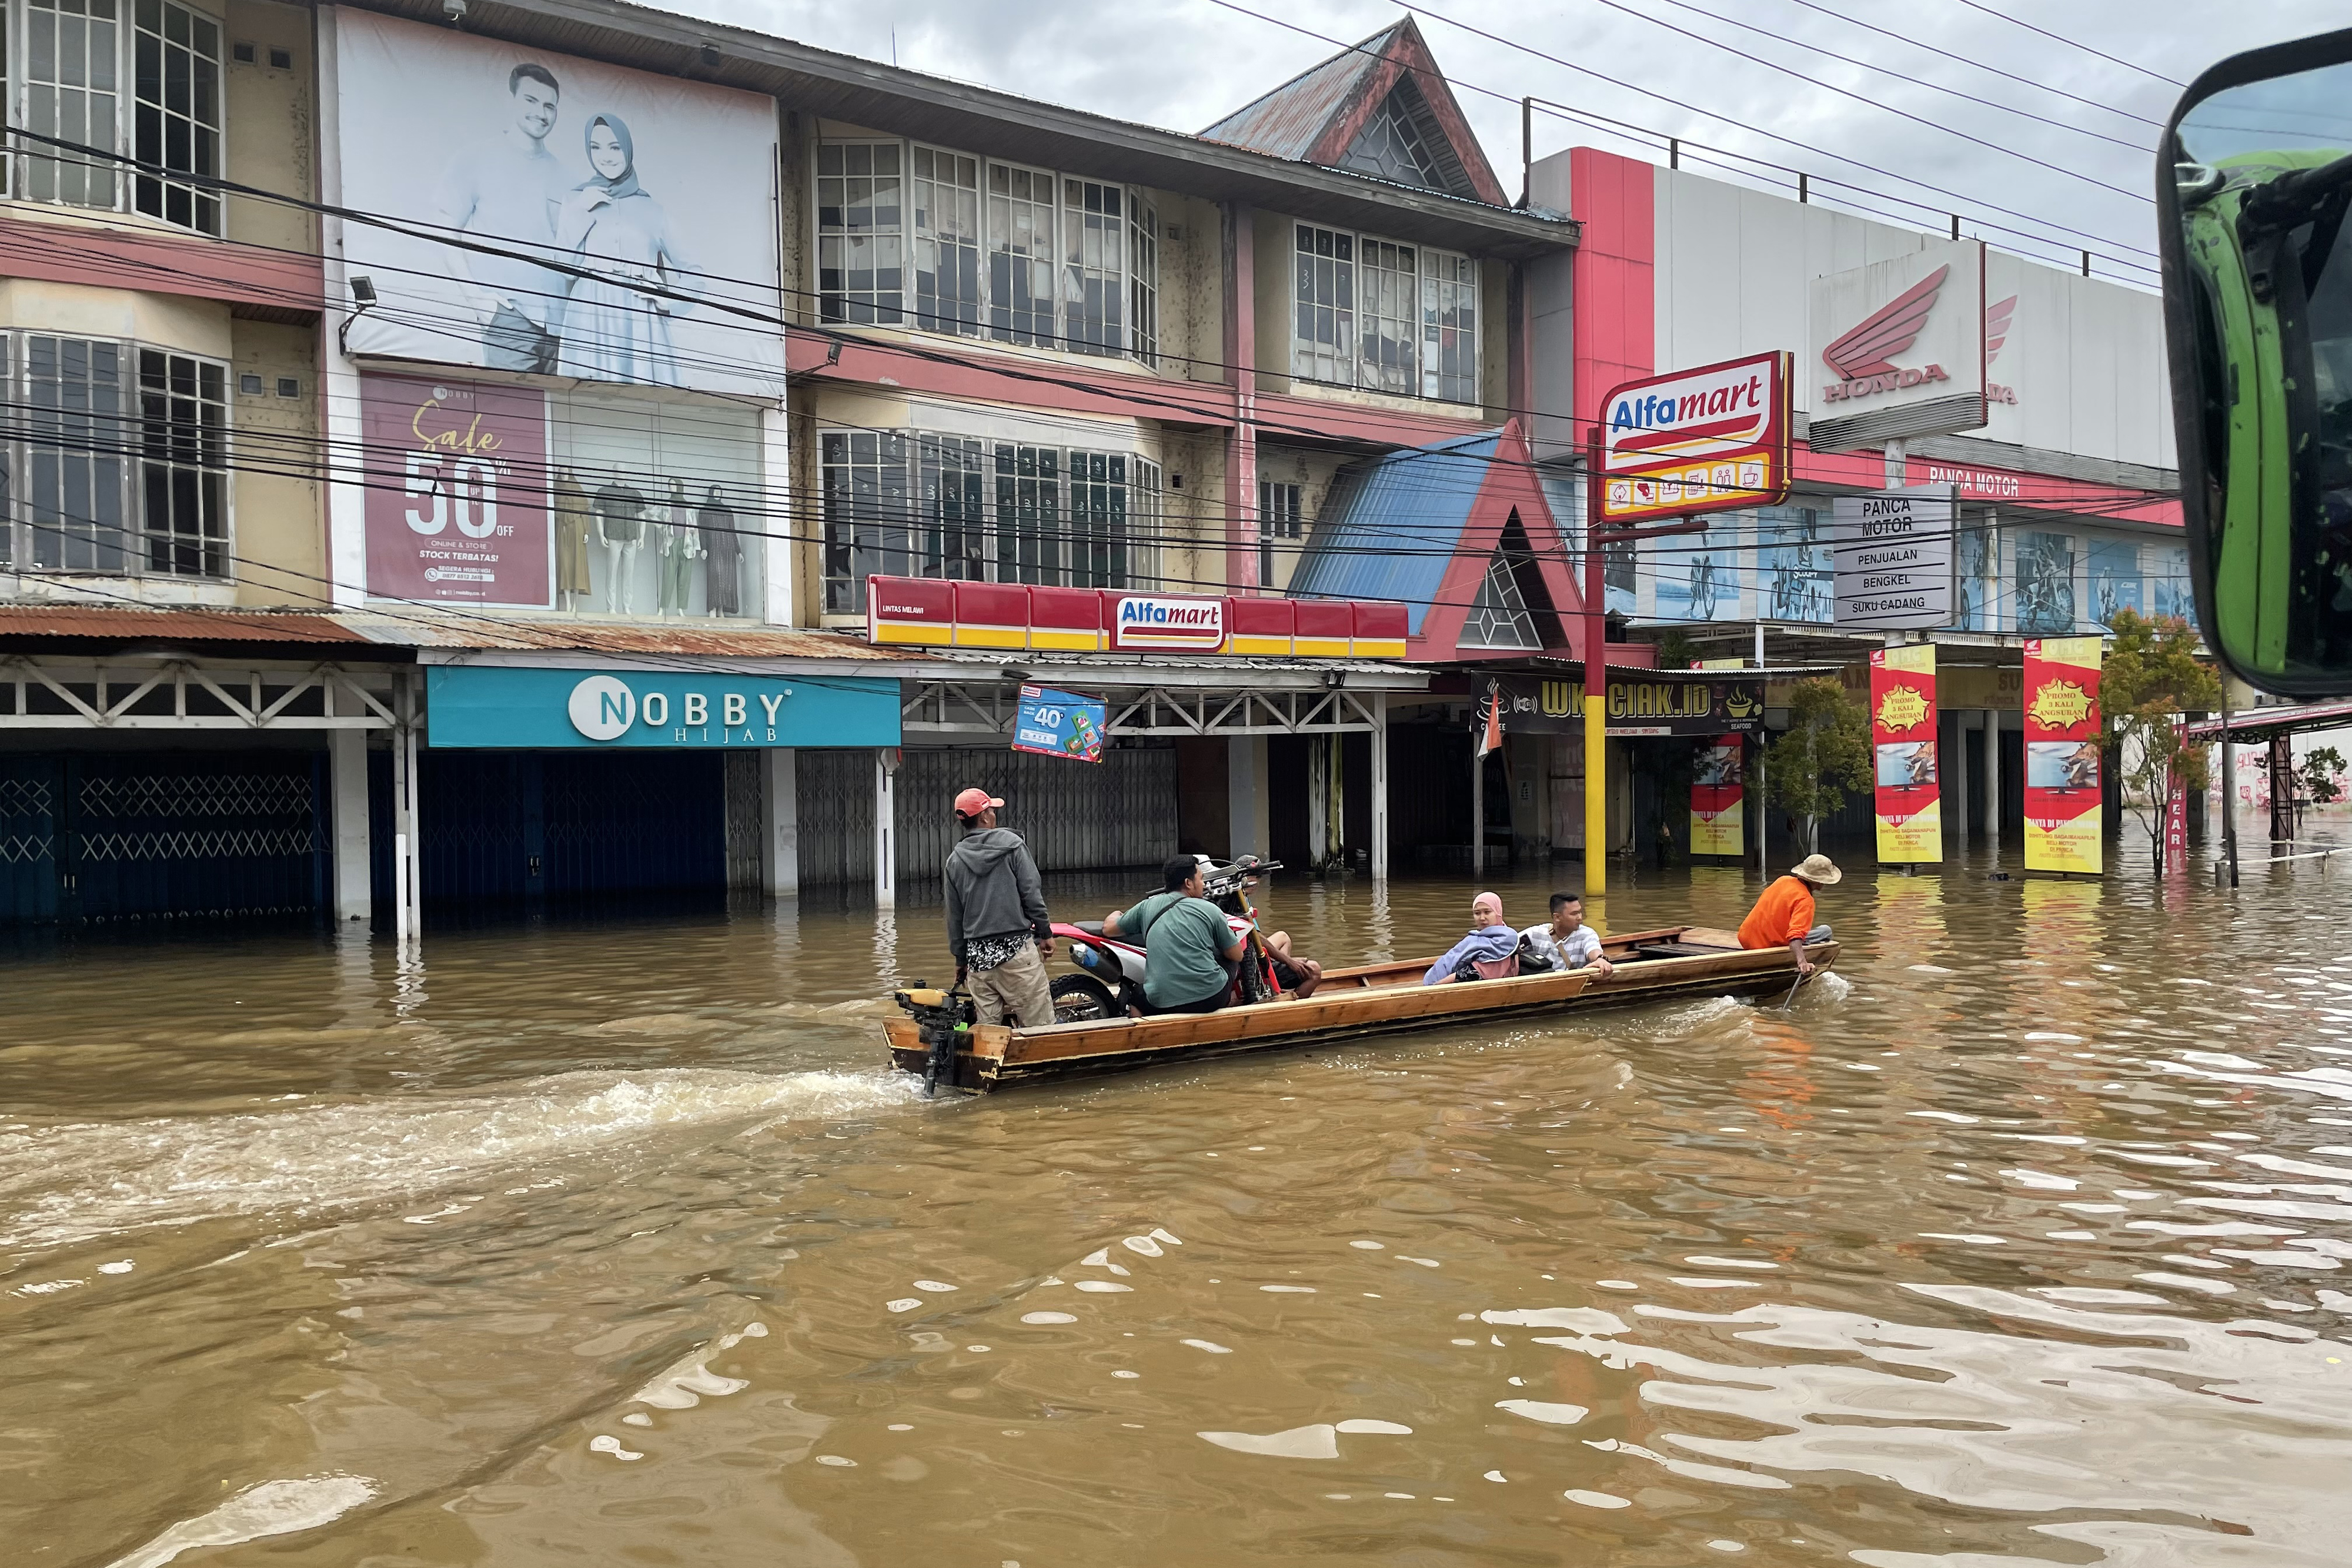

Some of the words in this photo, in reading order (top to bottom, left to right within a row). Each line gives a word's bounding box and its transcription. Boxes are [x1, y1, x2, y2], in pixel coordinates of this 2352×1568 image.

[1823, 364, 1950, 403] HONDA
[440, 389, 475, 400] NOBBY
[1612, 375, 1762, 433] Alfamart
[413, 399, 502, 456] Sale
[1930, 467, 1972, 491] PANCA
[1976, 473, 2019, 497] MOTOR
[1863, 500, 1911, 517] PANCA
[496, 526, 514, 536] OFF
[1862, 516, 1912, 536] MOTOR
[419, 550, 450, 559] STOCK
[453, 552, 499, 562] TERBATAS!
[1858, 550, 1917, 566] PENJUALAN
[1863, 575, 1911, 589] BENGKEL
[1122, 601, 1219, 624] Alfamart
[1852, 601, 1877, 613] SUKU
[1880, 597, 1925, 610] CADANG
[2048, 639, 2084, 656] OMG
[601, 691, 784, 727] NOBBY
[1885, 711, 1922, 720] ANGSURAN
[675, 727, 777, 743] HIJAB
[2047, 819, 2054, 828] DI
